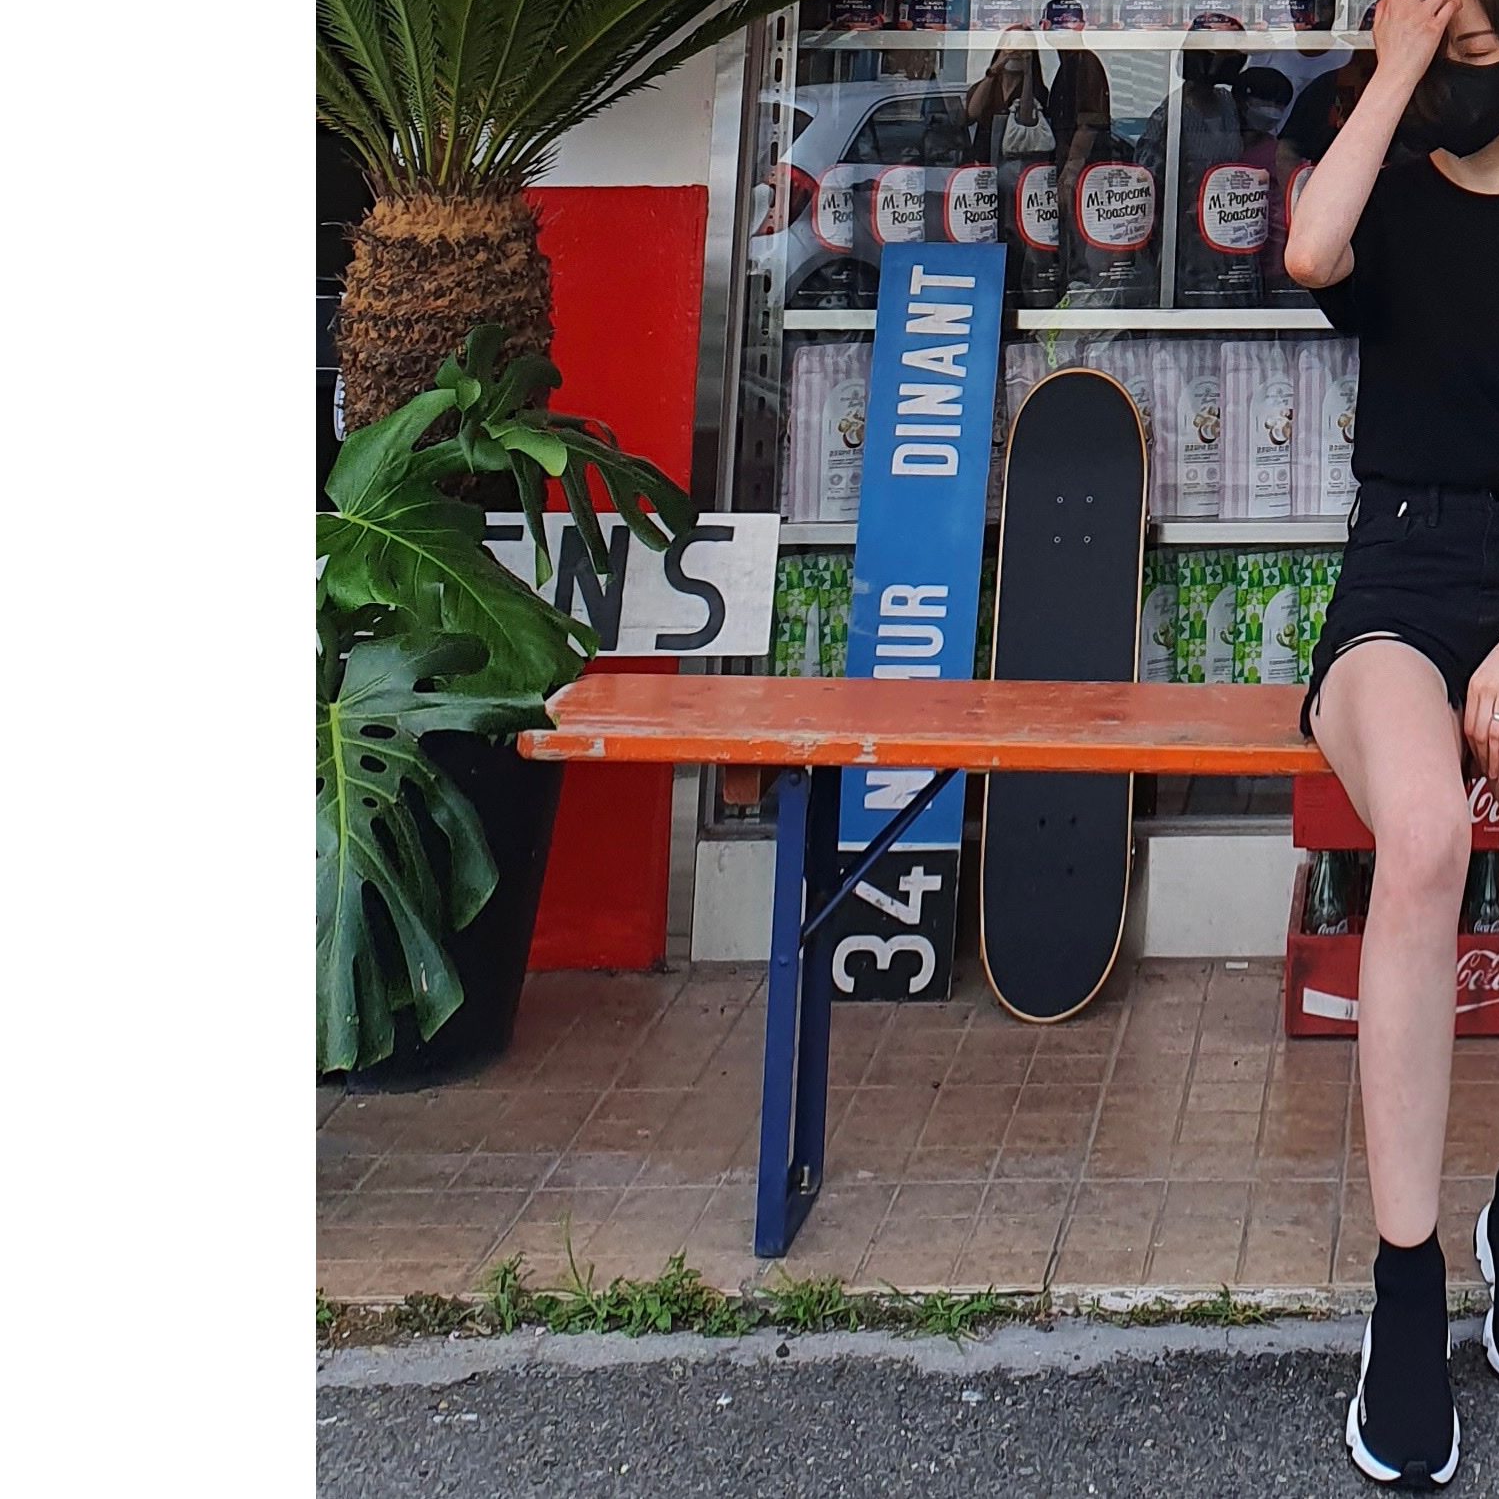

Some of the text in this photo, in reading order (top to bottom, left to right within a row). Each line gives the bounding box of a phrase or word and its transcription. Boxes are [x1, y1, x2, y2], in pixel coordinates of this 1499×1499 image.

[822, 193, 840, 210] M.
[882, 194, 899, 210] M.
[954, 193, 971, 210] M.
[1026, 192, 1043, 209] M.
[1086, 186, 1151, 208] M. Popcorn
[1208, 194, 1225, 210] M.
[891, 210, 925, 225] Roas
[963, 209, 999, 224] Roast
[1095, 203, 1147, 222] Roastery
[485, 524, 735, 651] NS
[832, 264, 976, 994] 34 NUR DINANT
